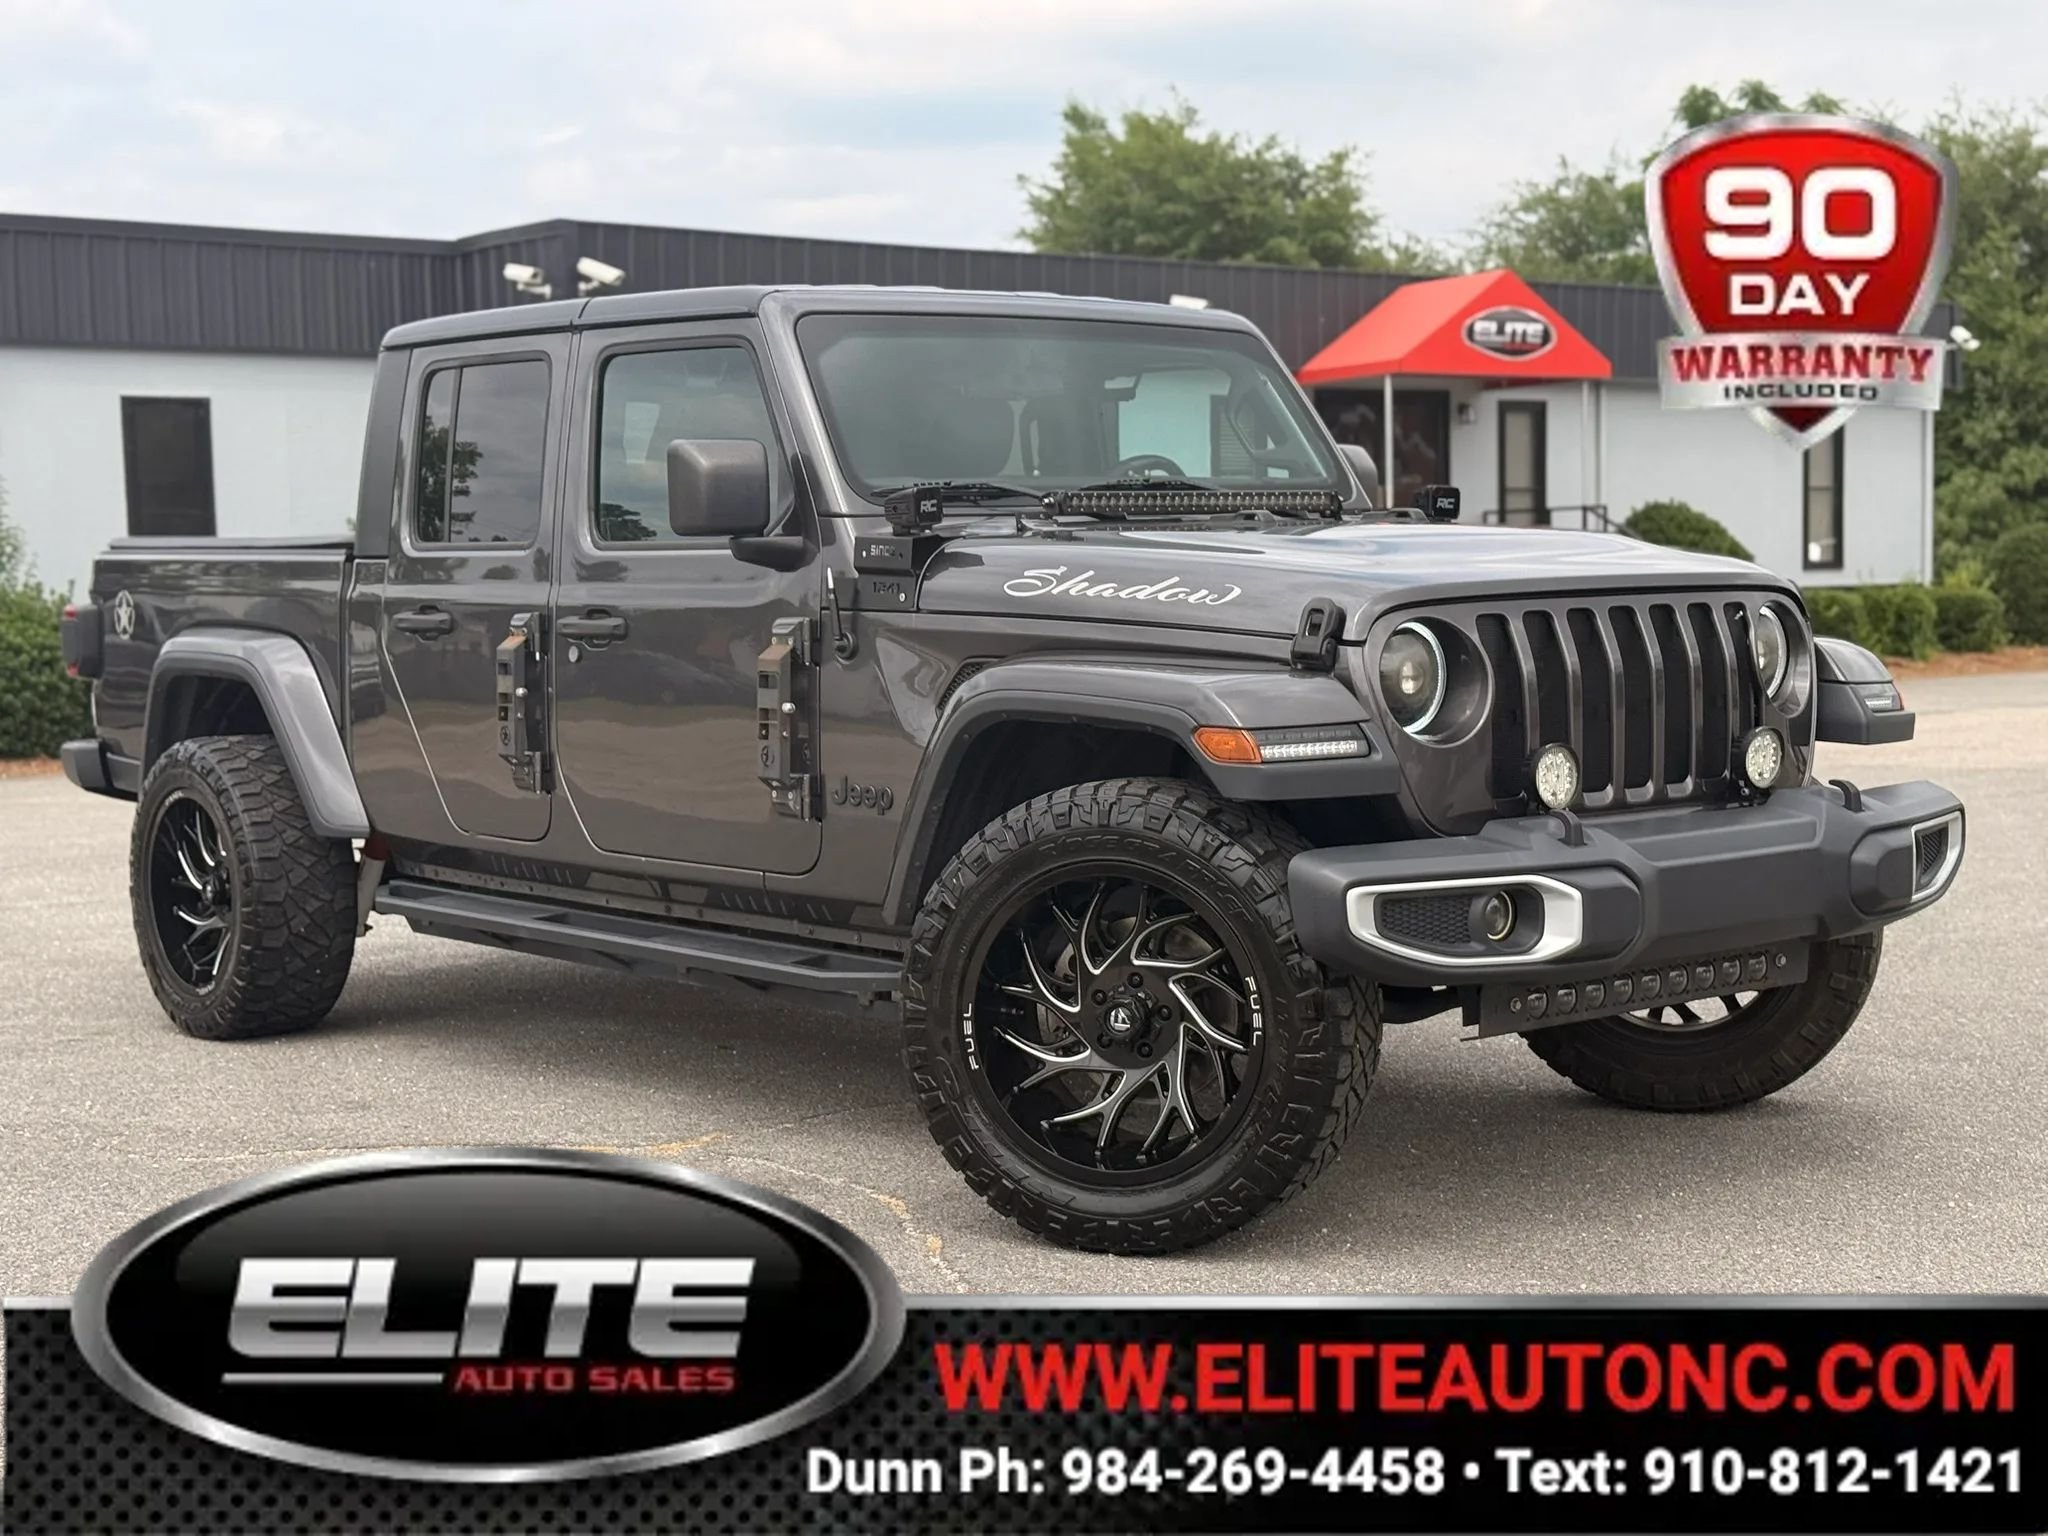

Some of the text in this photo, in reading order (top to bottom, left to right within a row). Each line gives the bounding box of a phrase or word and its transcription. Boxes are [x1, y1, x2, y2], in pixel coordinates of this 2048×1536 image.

[1473, 320, 1545, 343] ELITE
[920, 499, 938, 513] RC
[1436, 498, 1455, 509] RC
[1004, 566, 1242, 606] Shadow
[832, 775, 894, 816] Jeep
[1245, 976, 1262, 1047] FUEL
[963, 1003, 979, 1070] FUEL
